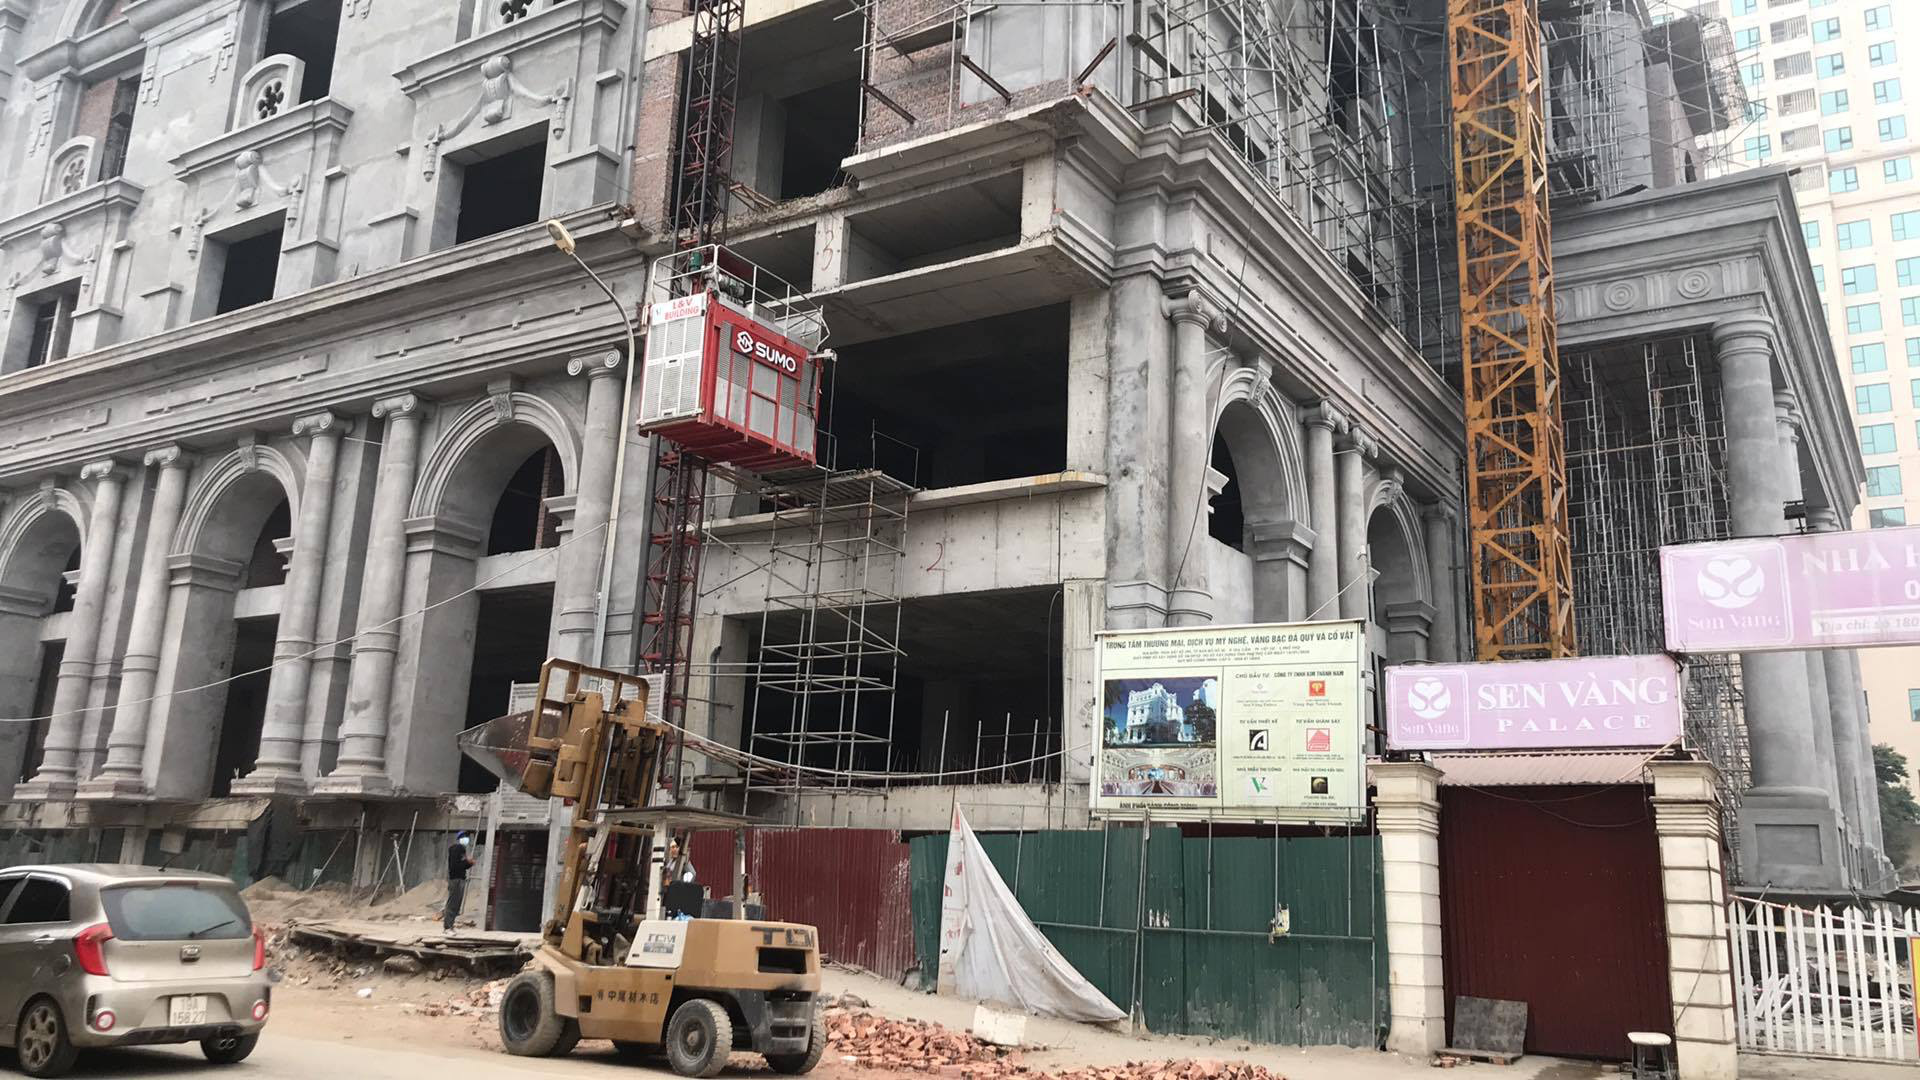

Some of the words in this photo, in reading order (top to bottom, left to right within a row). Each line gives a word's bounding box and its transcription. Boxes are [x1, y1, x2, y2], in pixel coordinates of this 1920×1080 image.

[664, 305, 700, 321] BUILDING
[755, 341, 797, 373] SUMO
[1106, 641, 1126, 649] TRUNG
[1477, 681, 1547, 711] SEN
[1558, 671, 1669, 708] VÀNG
[1496, 714, 1653, 733] PALACE
